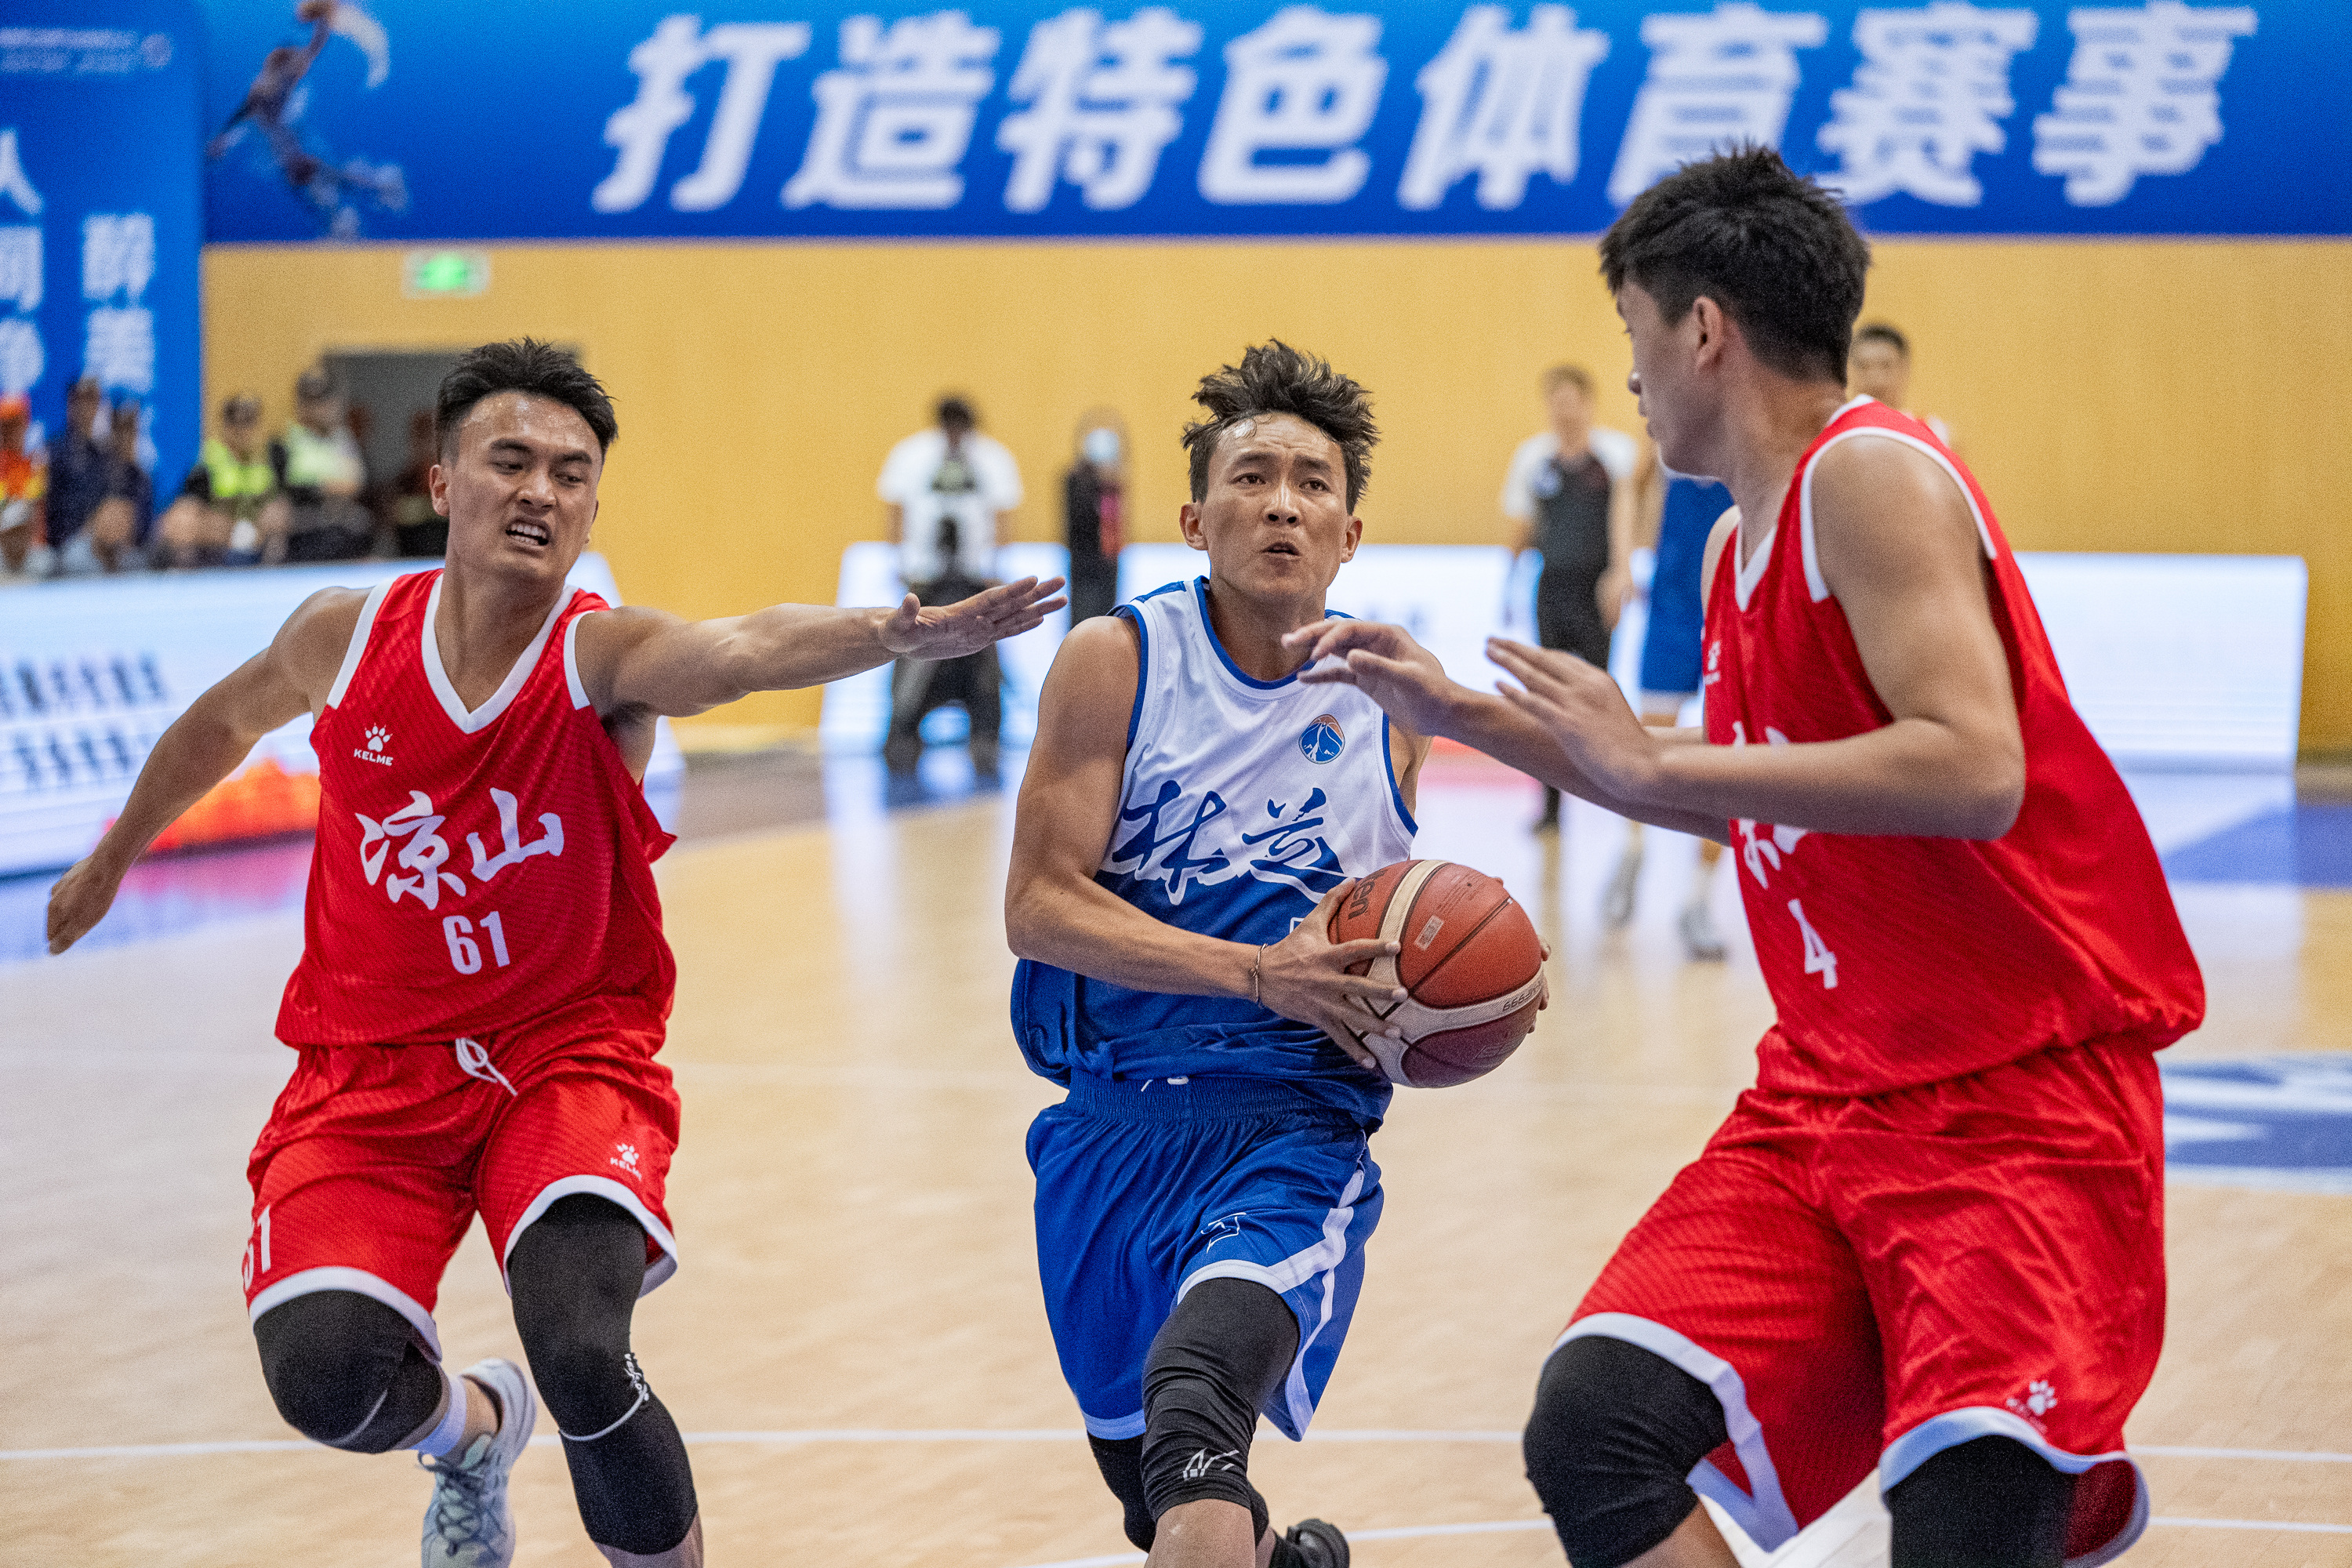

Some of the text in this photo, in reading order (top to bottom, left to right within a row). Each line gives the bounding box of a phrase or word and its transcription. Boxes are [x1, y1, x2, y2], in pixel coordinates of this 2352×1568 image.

[591, 2, 2257, 212] 打造特色体育赛事
[354, 748, 394, 766] KELME
[354, 786, 564, 910] 凉山
[441, 910, 511, 975] 61
[1788, 898, 1838, 989] 4
